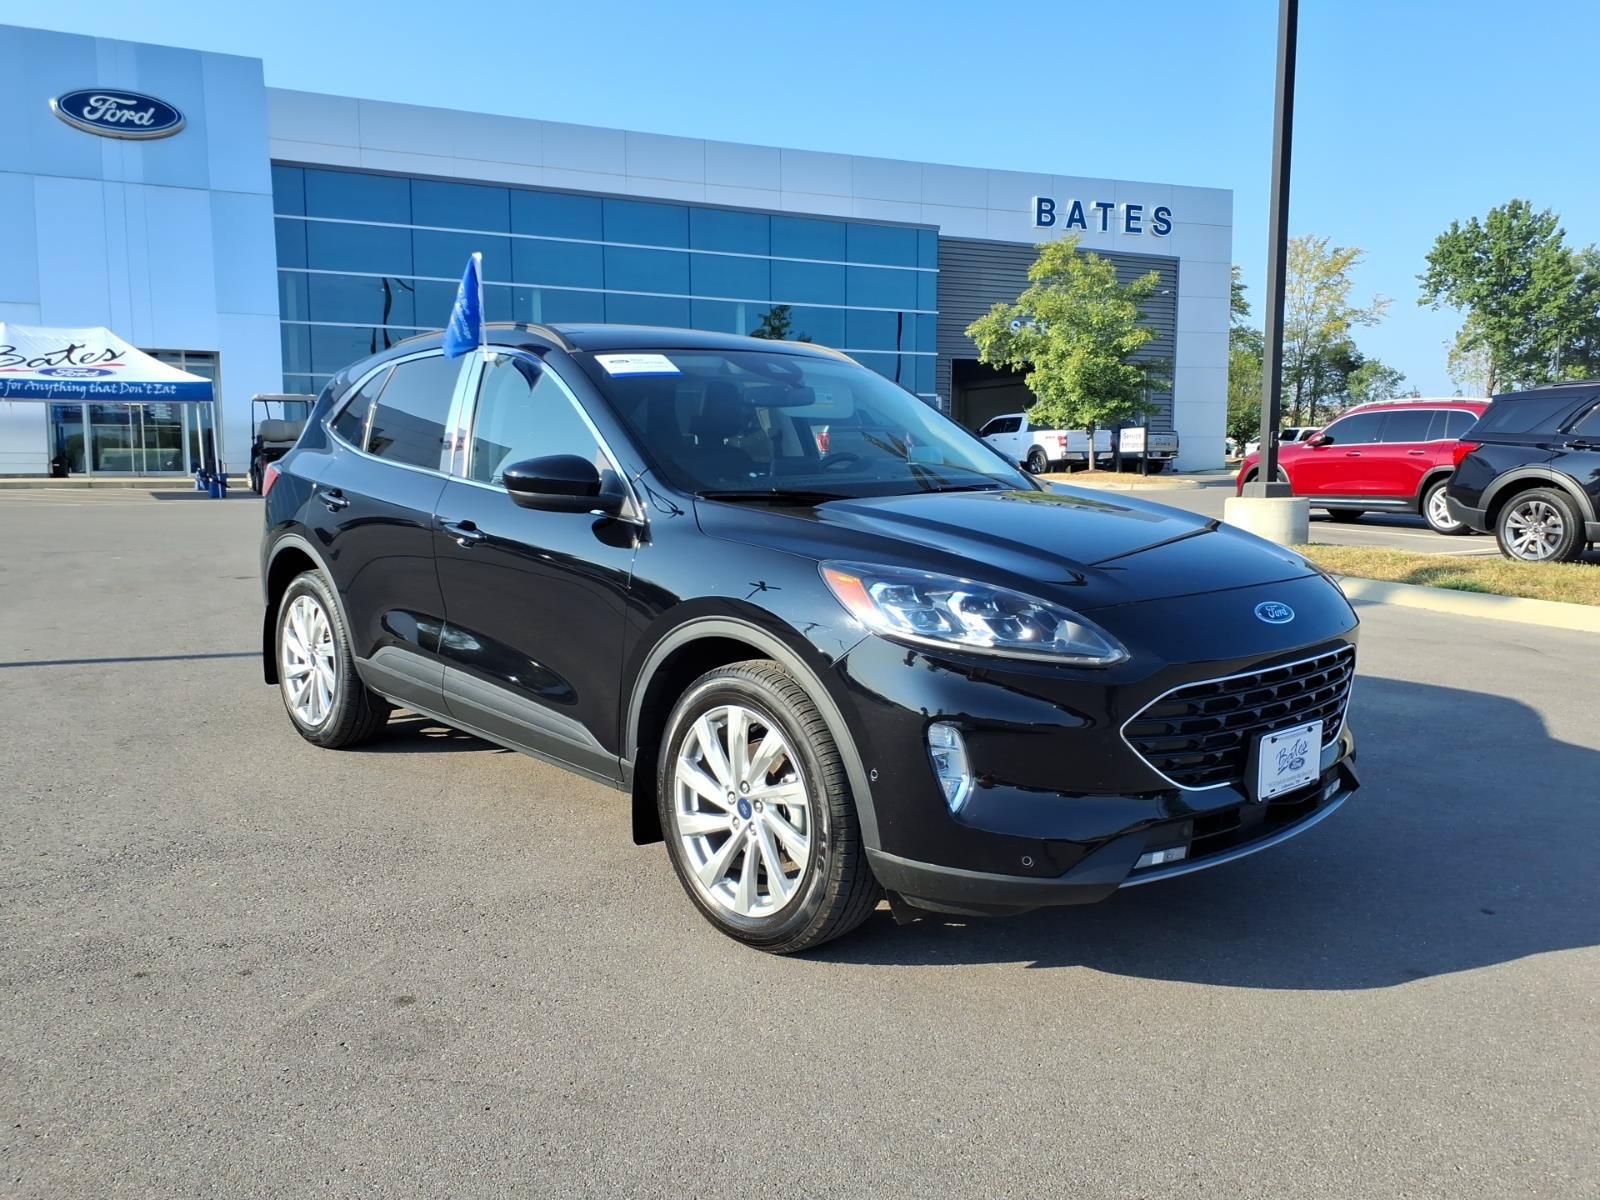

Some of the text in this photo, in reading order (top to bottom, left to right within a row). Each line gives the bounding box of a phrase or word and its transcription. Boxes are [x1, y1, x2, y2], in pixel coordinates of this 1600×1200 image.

[83, 96, 155, 125] Ford
[1033, 195, 1173, 236] BATES
[0, 344, 126, 367] Bates
[51, 368, 100, 377] Ford
[4, 379, 23, 397] for
[24, 380, 87, 399] Anything
[89, 382, 118, 394] that
[119, 383, 152, 394] Don't
[153, 384, 177, 394] Eat
[1265, 605, 1288, 618] Ford
